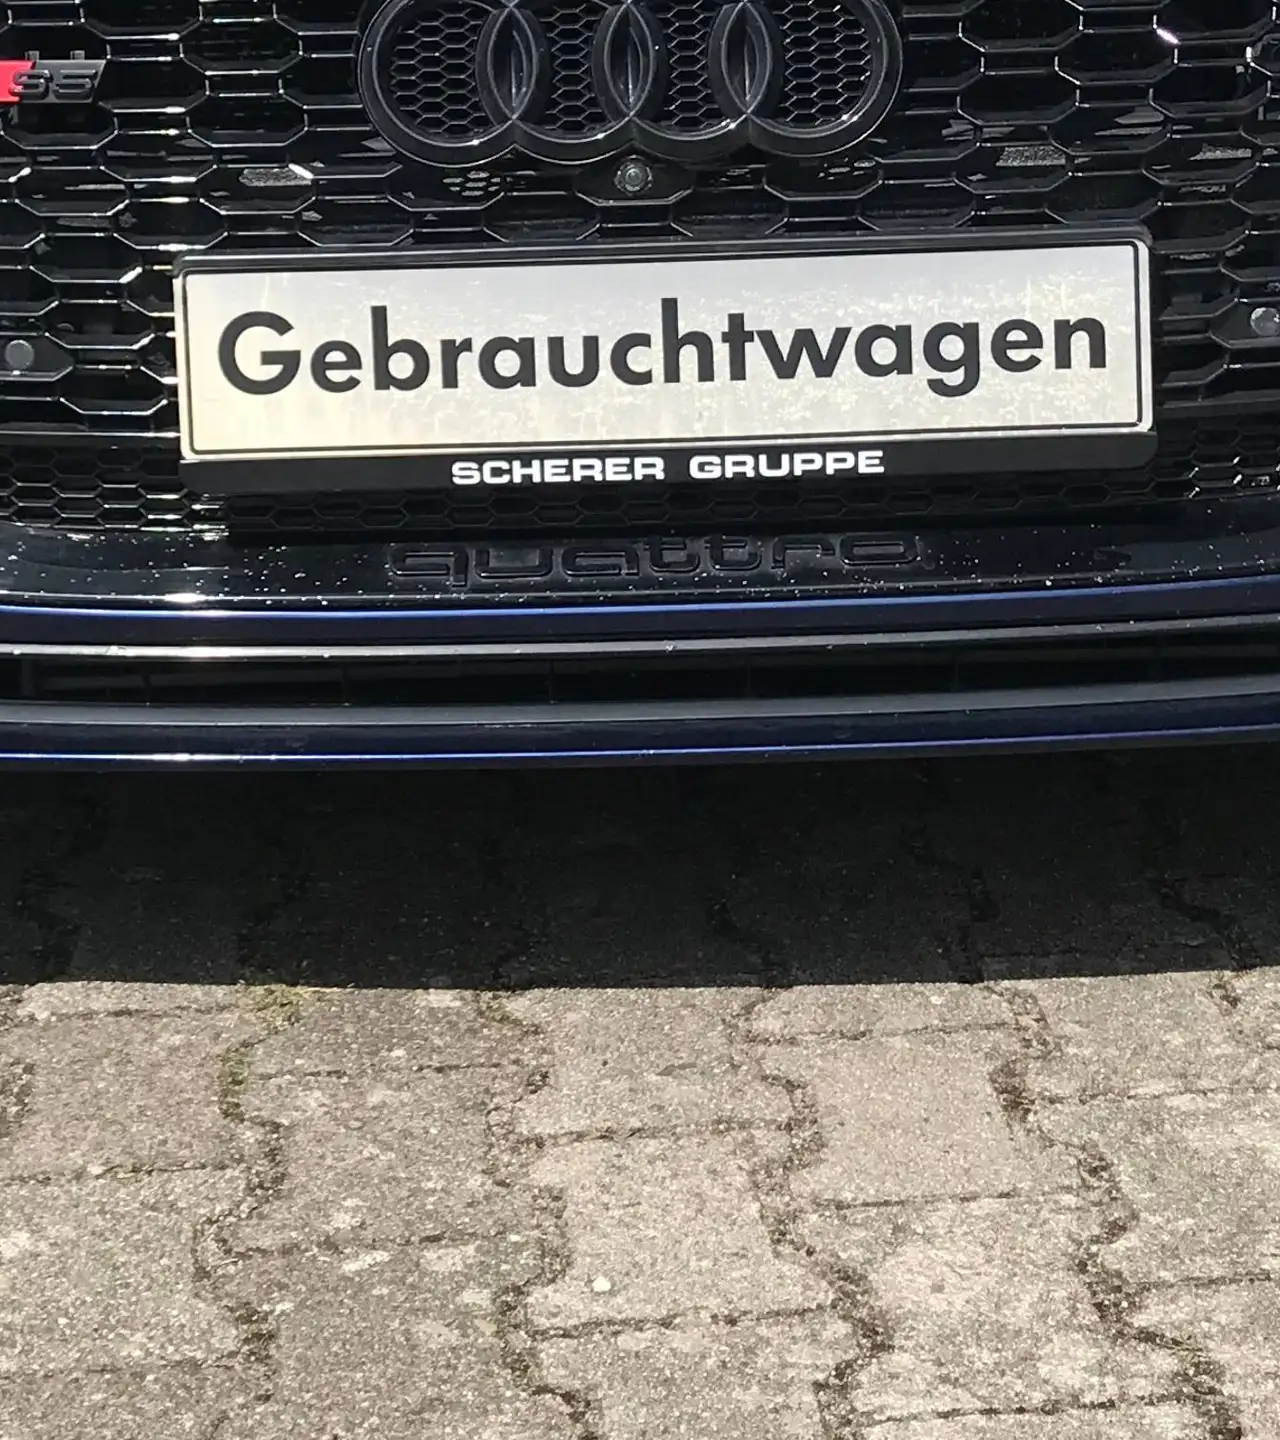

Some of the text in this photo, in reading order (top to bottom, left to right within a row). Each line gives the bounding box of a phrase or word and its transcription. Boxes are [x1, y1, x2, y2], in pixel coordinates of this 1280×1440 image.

[8, 69, 94, 99] S5
[216, 297, 1107, 398] Gebrauchtwagen
[451, 450, 885, 486] SCHERER GRUPPE
[389, 533, 922, 588] quattro
